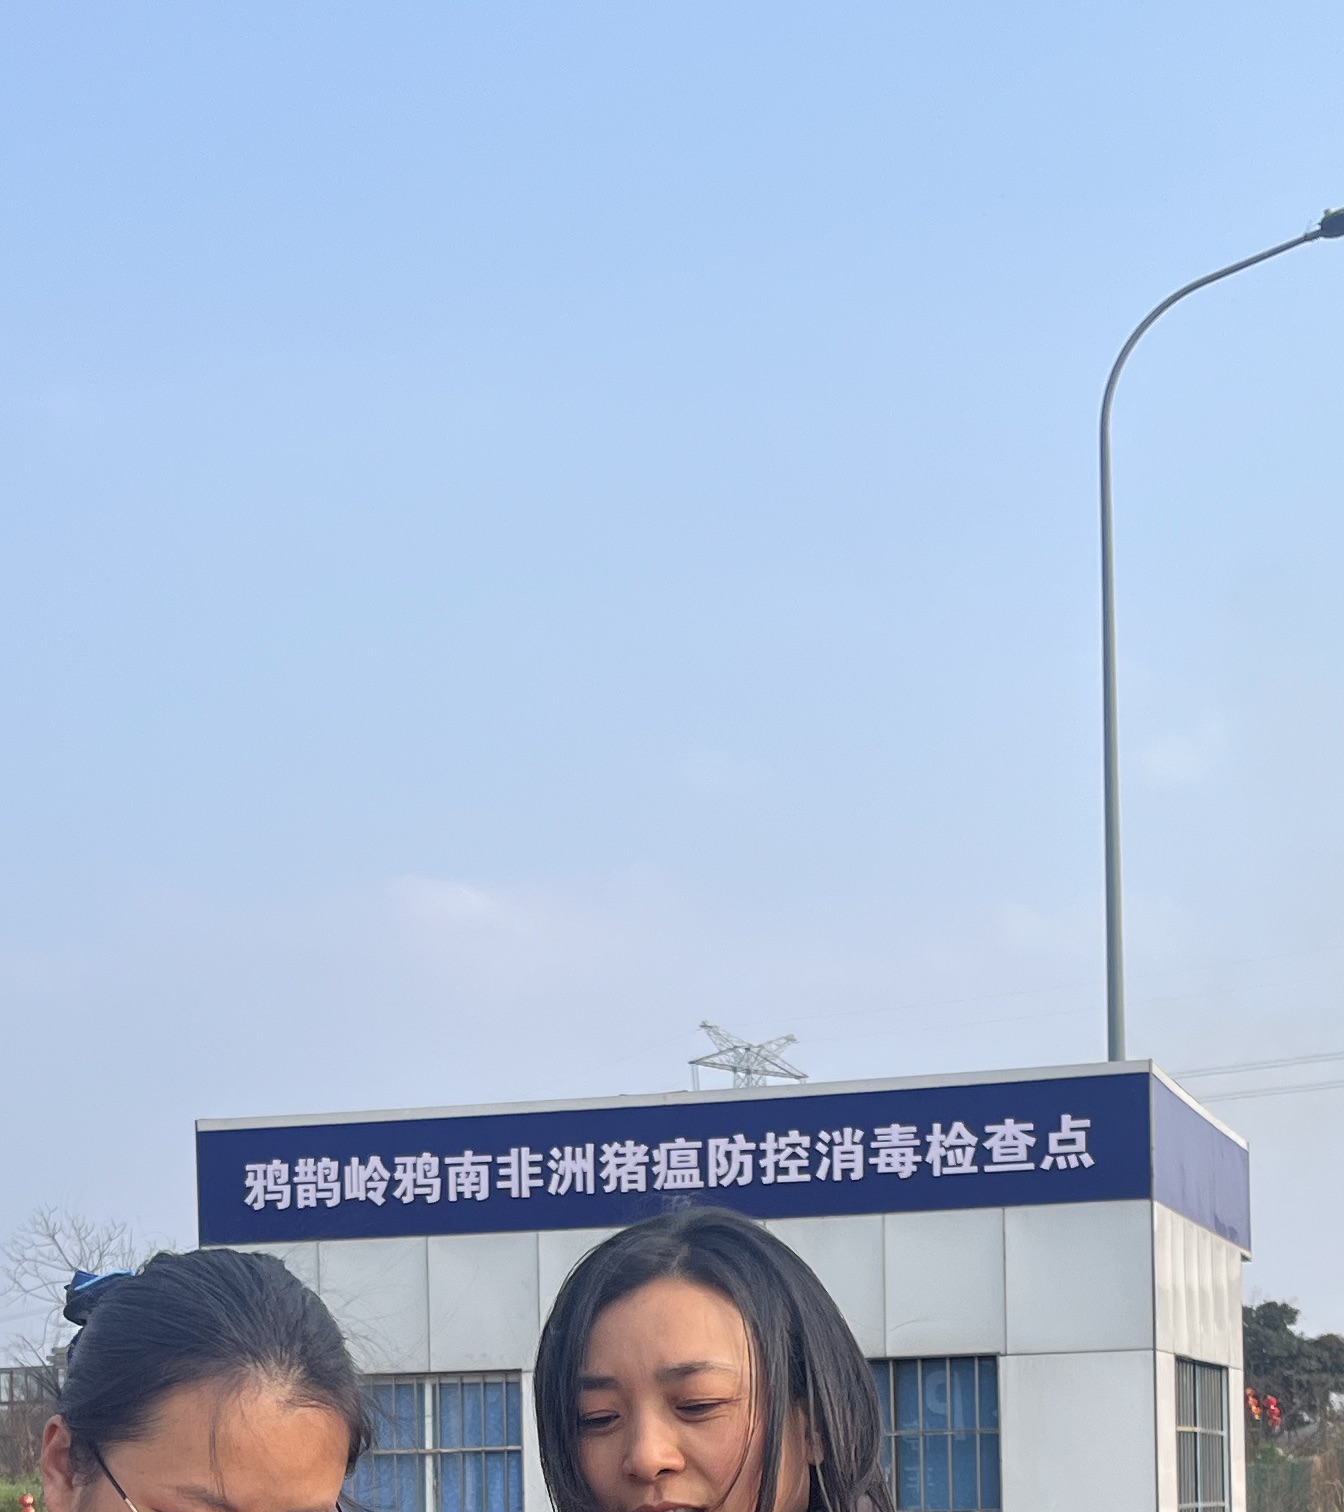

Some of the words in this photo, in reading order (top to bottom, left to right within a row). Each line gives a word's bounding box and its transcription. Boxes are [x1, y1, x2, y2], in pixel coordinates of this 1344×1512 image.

[244, 1114, 1095, 1211] 鸦鹊岭鸦南非洲猪瘟防控消毒检查点
